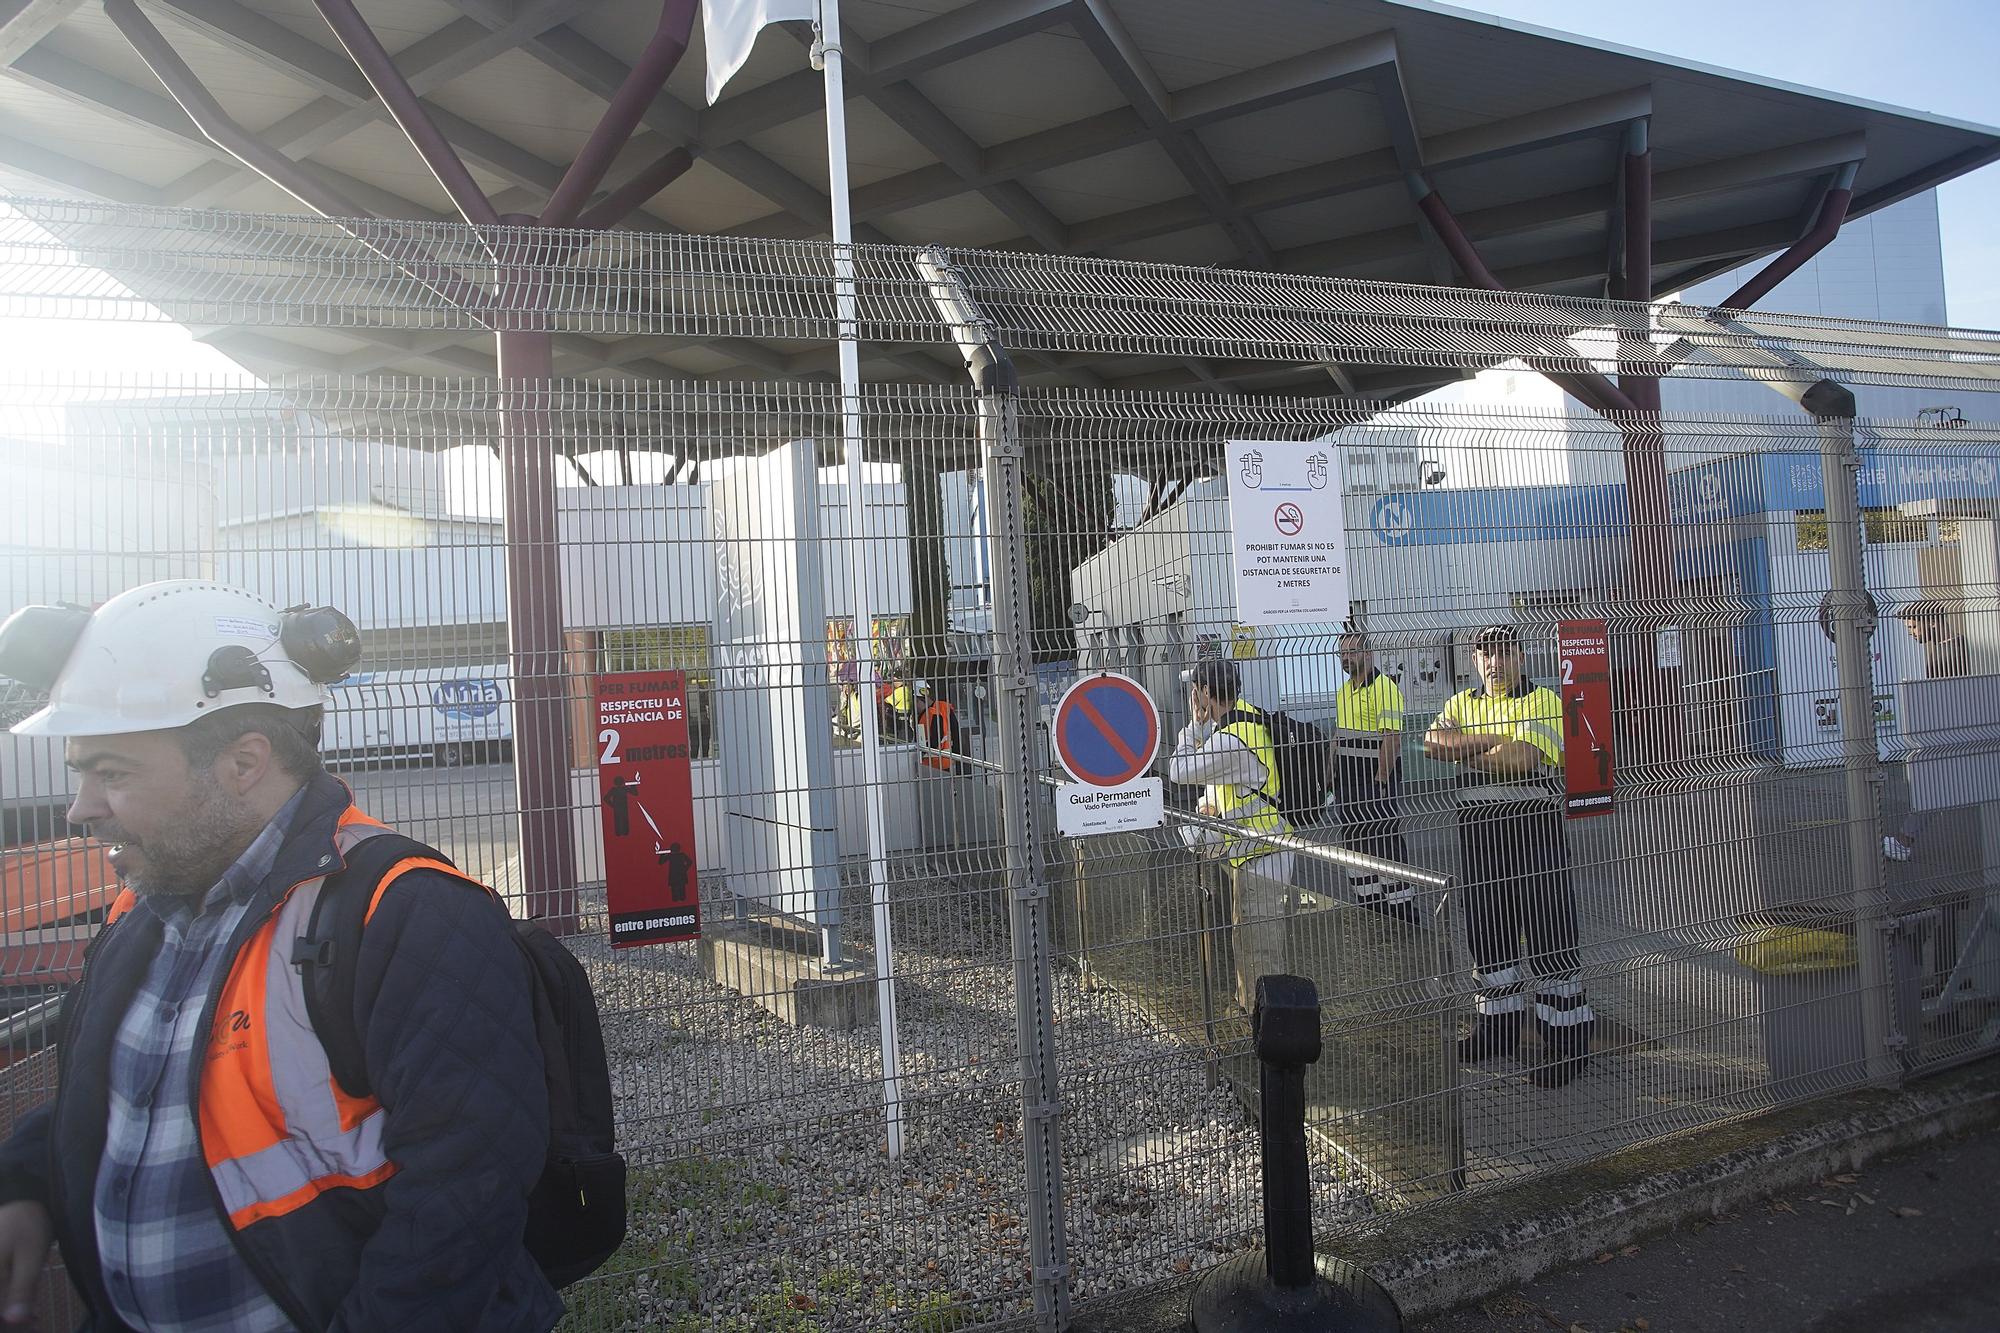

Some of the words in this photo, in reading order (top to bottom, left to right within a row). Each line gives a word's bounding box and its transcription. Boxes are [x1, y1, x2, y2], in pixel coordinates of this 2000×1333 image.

[1246, 543, 1278, 552] PROHIBIT
[1280, 542, 1306, 551] FUMAR
[1307, 542, 1314, 551] SI
[1314, 542, 1326, 551] NO
[1326, 542, 1335, 550] ES
[1257, 556, 1271, 564] POT
[1272, 555, 1310, 564] MANTENIR
[1310, 555, 1327, 563] UNA
[1242, 568, 1280, 577] DISTANCIA
[1281, 568, 1291, 576] DE
[1292, 566, 1331, 576] SEGURETAT
[1331, 566, 1341, 574] DE
[1277, 580, 1282, 588] 2
[1283, 579, 1311, 588] METRES
[1561, 638, 1595, 647] RESPECTEU
[1596, 638, 1605, 646] LA
[1561, 647, 1596, 656] DISTÀNCIA
[1596, 647, 1606, 655] DE
[1561, 659, 1574, 685] 2
[599, 682, 625, 695] PER
[629, 680, 679, 694] FUMAR
[438, 685, 498, 704] Núria
[600, 699, 663, 712] RESPECTEU
[666, 697, 681, 708] LA
[600, 710, 664, 725] DISTÀNCIA
[667, 710, 682, 720] DE
[599, 729, 621, 765] 2
[625, 743, 688, 762] metres
[1070, 792, 1094, 805] Gual
[1096, 788, 1151, 802] Permanent
[1568, 799, 1584, 808] entre
[1585, 796, 1612, 808] persones
[1101, 799, 1138, 809] Permanente
[614, 919, 644, 933] entre
[645, 912, 696, 930] persones
